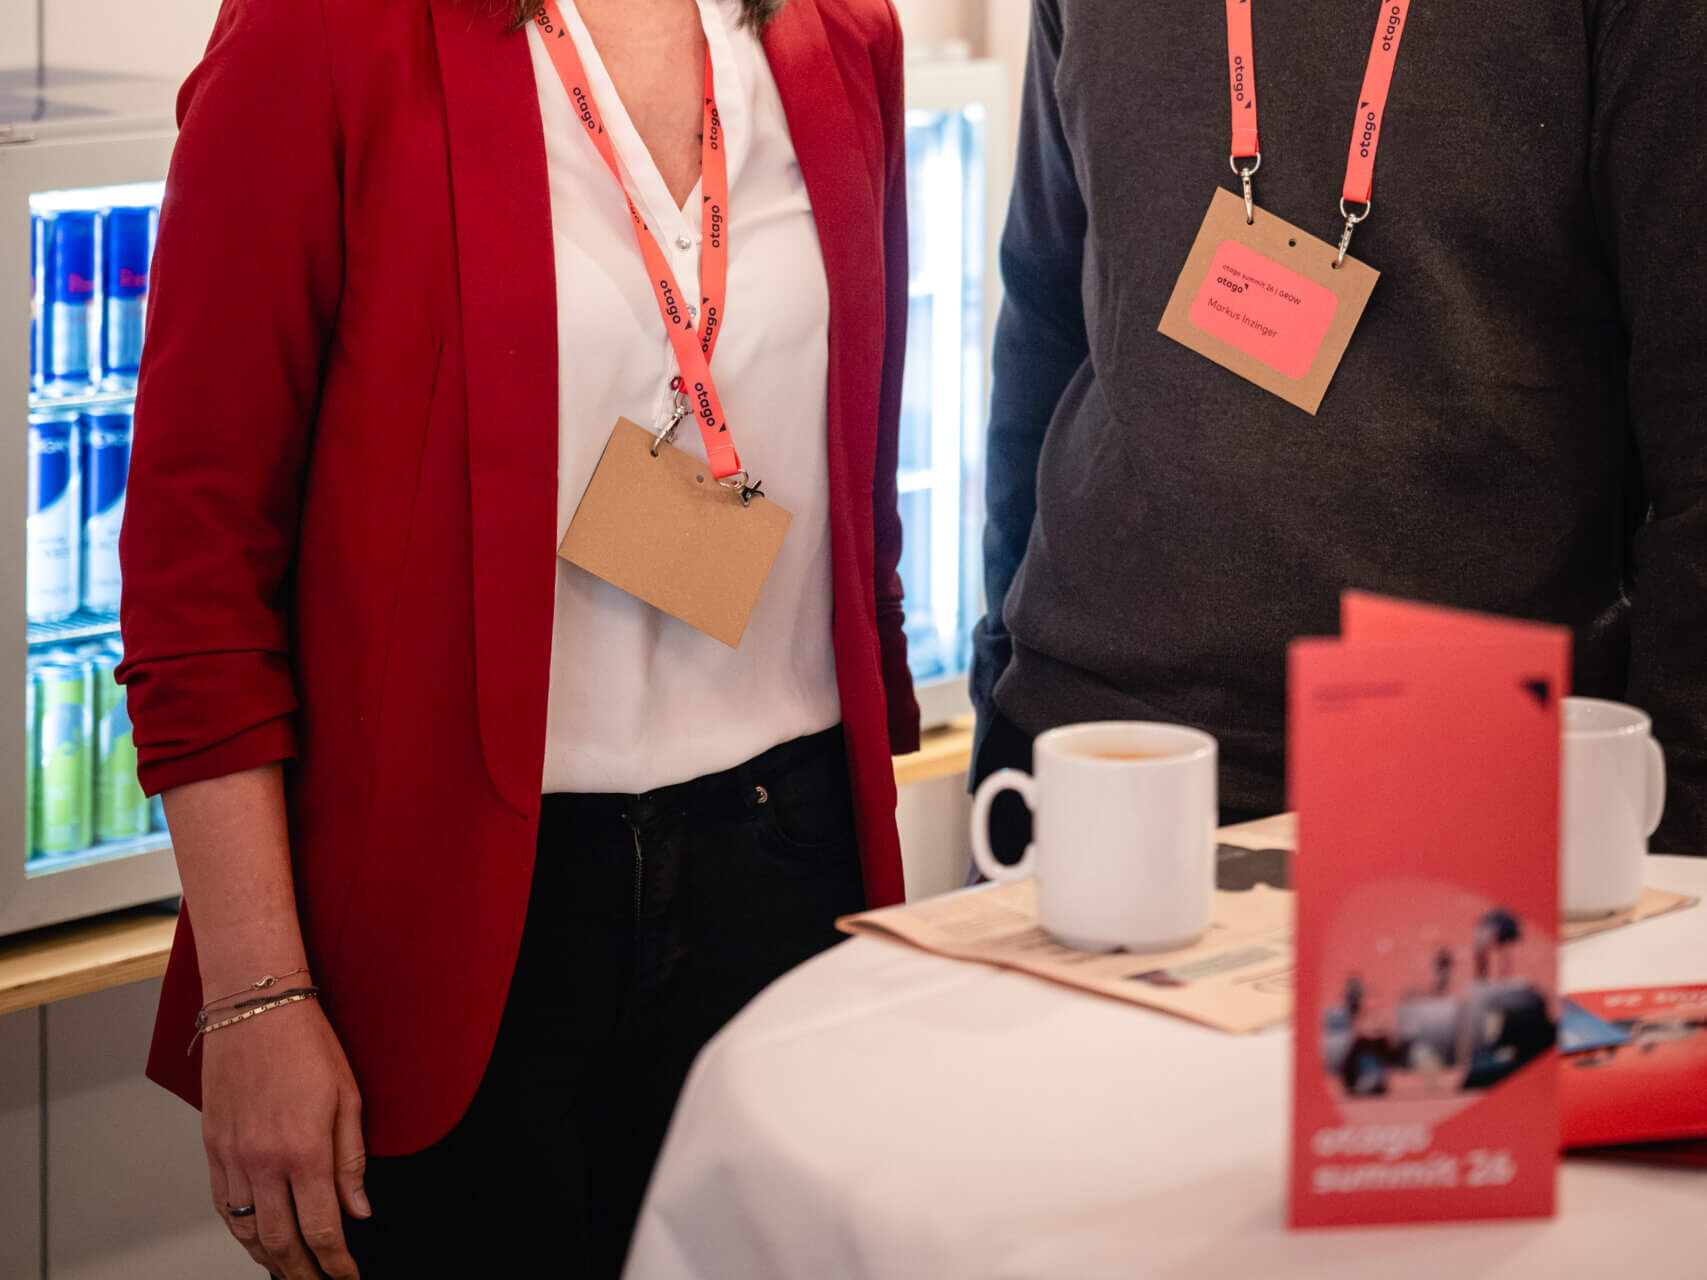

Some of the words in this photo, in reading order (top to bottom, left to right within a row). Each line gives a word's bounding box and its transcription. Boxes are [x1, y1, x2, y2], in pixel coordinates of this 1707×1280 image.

[537, 7, 553, 33] ago
[1382, 5, 1401, 51] otago
[1233, 56, 1244, 101] otago
[573, 87, 595, 129] otago
[710, 108, 720, 150] otago
[1360, 111, 1376, 158] otago
[710, 205, 723, 248] otago
[660, 280, 681, 324] otago
[1216, 276, 1244, 293] otago
[1279, 290, 1301, 304] GROW
[702, 307, 716, 352] otago
[1208, 297, 1241, 320] Markus
[1242, 314, 1278, 338] Inzinger
[695, 382, 715, 426] otago
[1313, 1153, 1457, 1193] summit
